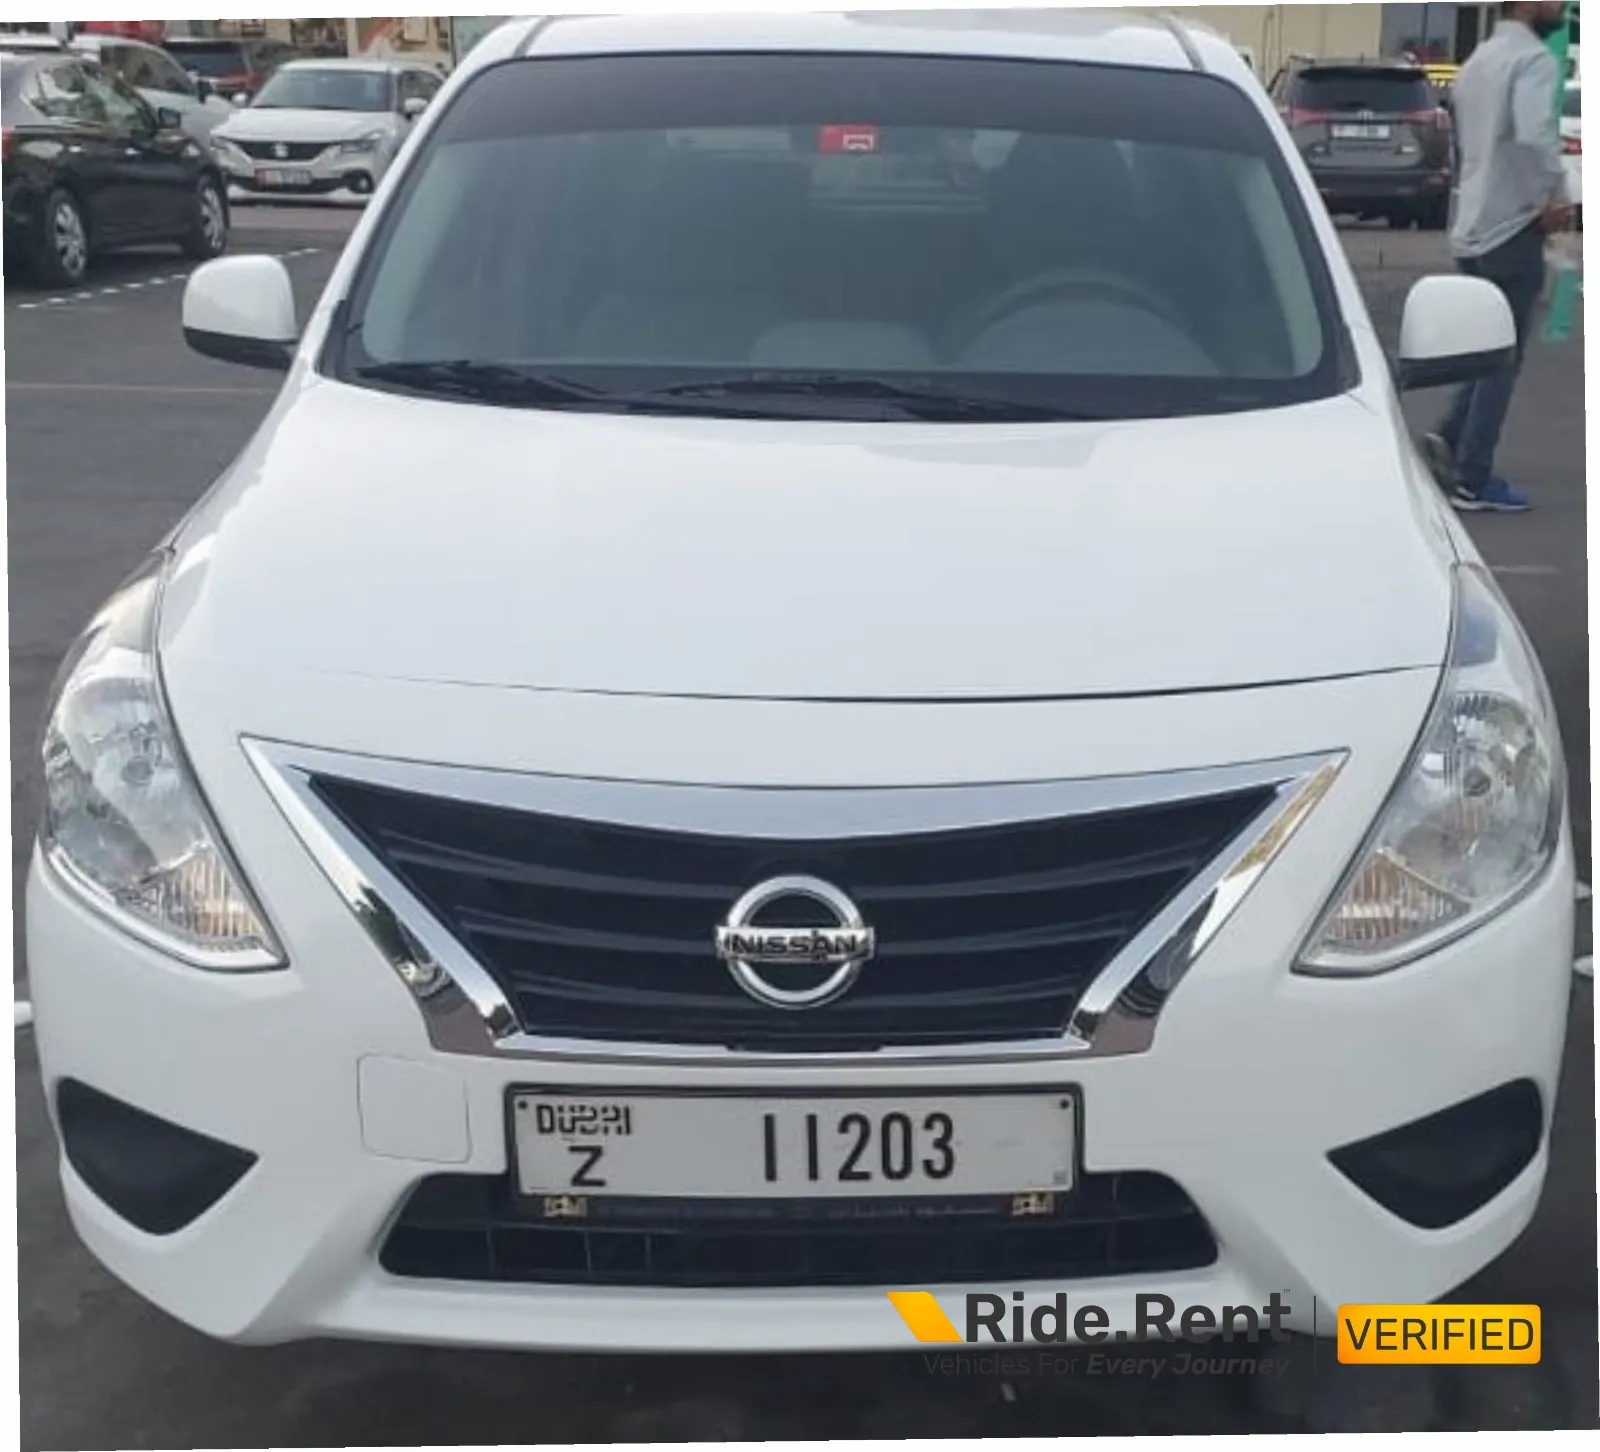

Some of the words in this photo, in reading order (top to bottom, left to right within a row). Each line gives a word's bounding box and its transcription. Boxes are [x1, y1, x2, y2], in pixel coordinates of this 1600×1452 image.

[724, 933, 858, 955] NISSAN
[536, 1103, 632, 1136] DUBAI
[763, 1111, 956, 1182] 11203
[568, 1145, 606, 1187] Z
